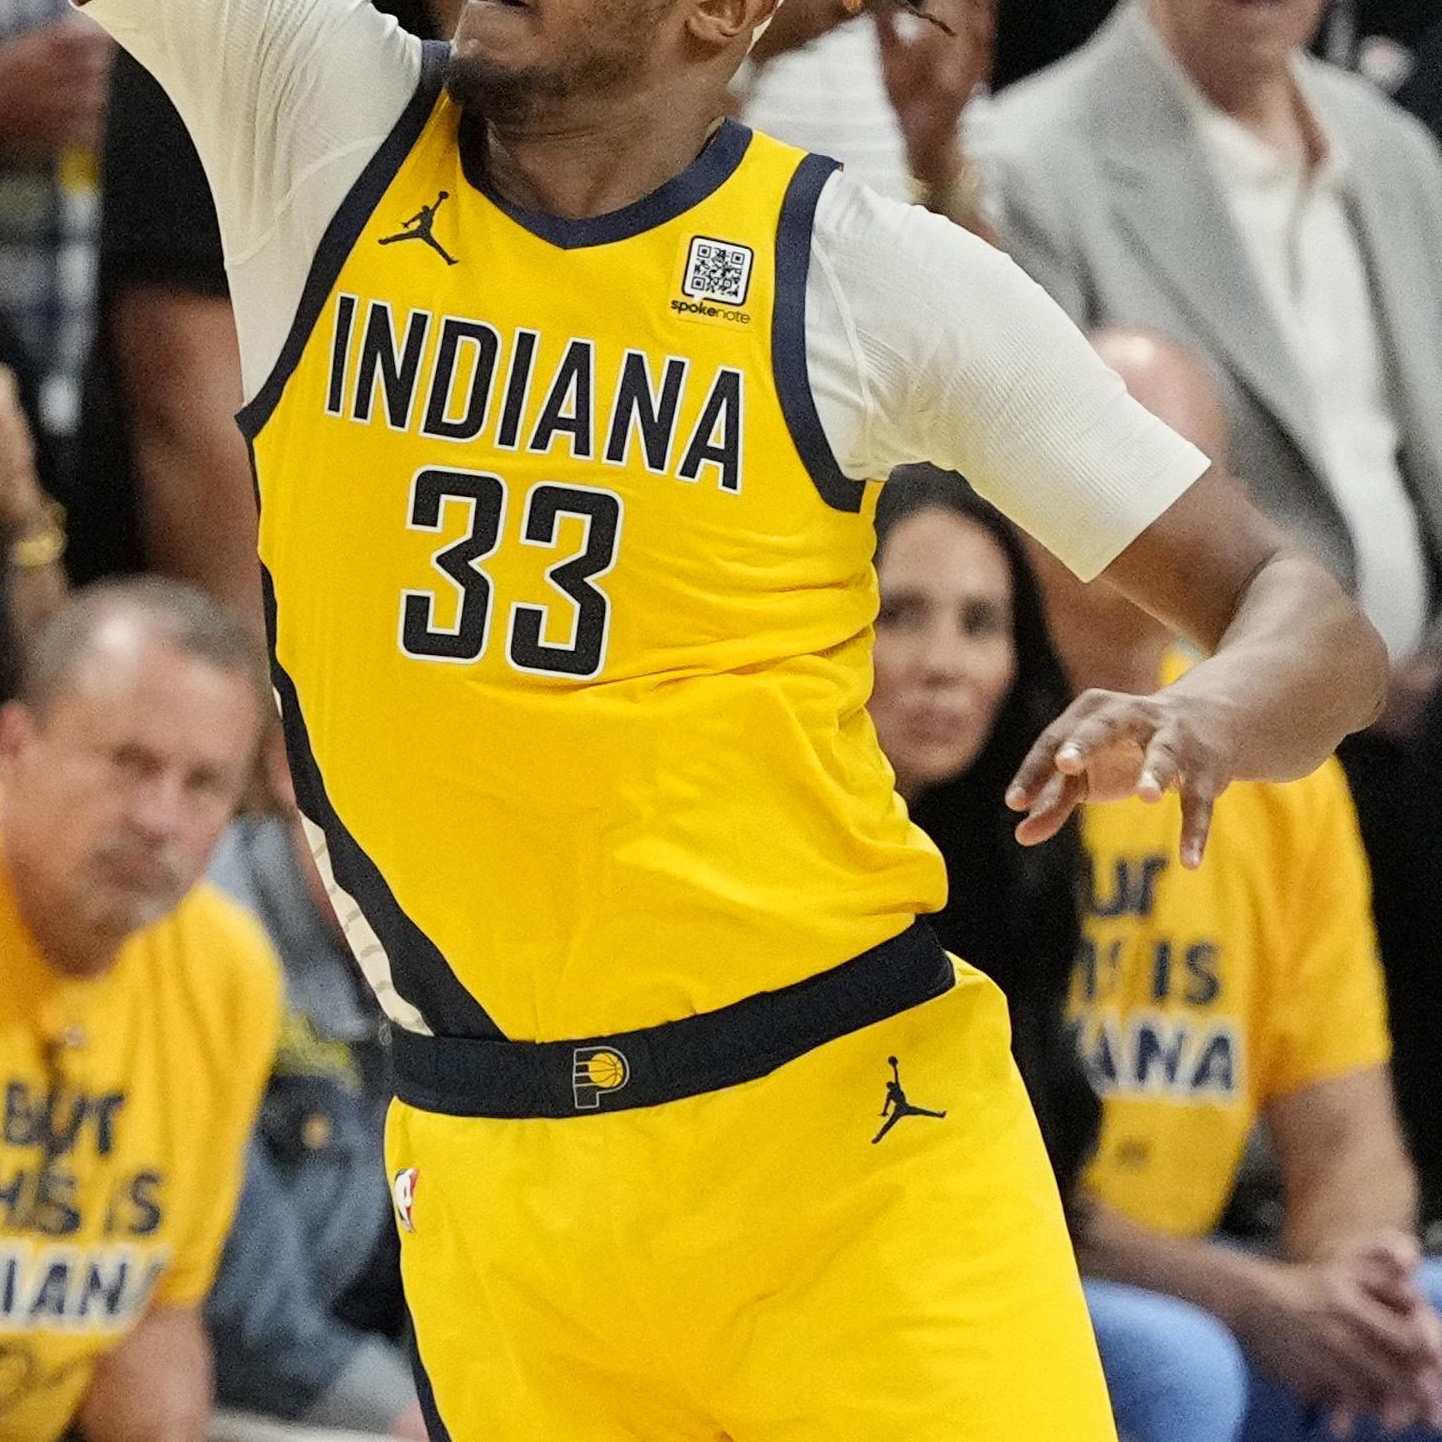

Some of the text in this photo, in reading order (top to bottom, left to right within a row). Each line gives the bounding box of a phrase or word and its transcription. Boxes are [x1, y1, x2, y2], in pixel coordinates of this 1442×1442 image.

[670, 299, 751, 324] spokenote
[325, 292, 745, 496] INDIANA
[396, 464, 624, 681] 33
[1153, 940, 1222, 1004] IS
[3, 1080, 126, 1156] BUT
